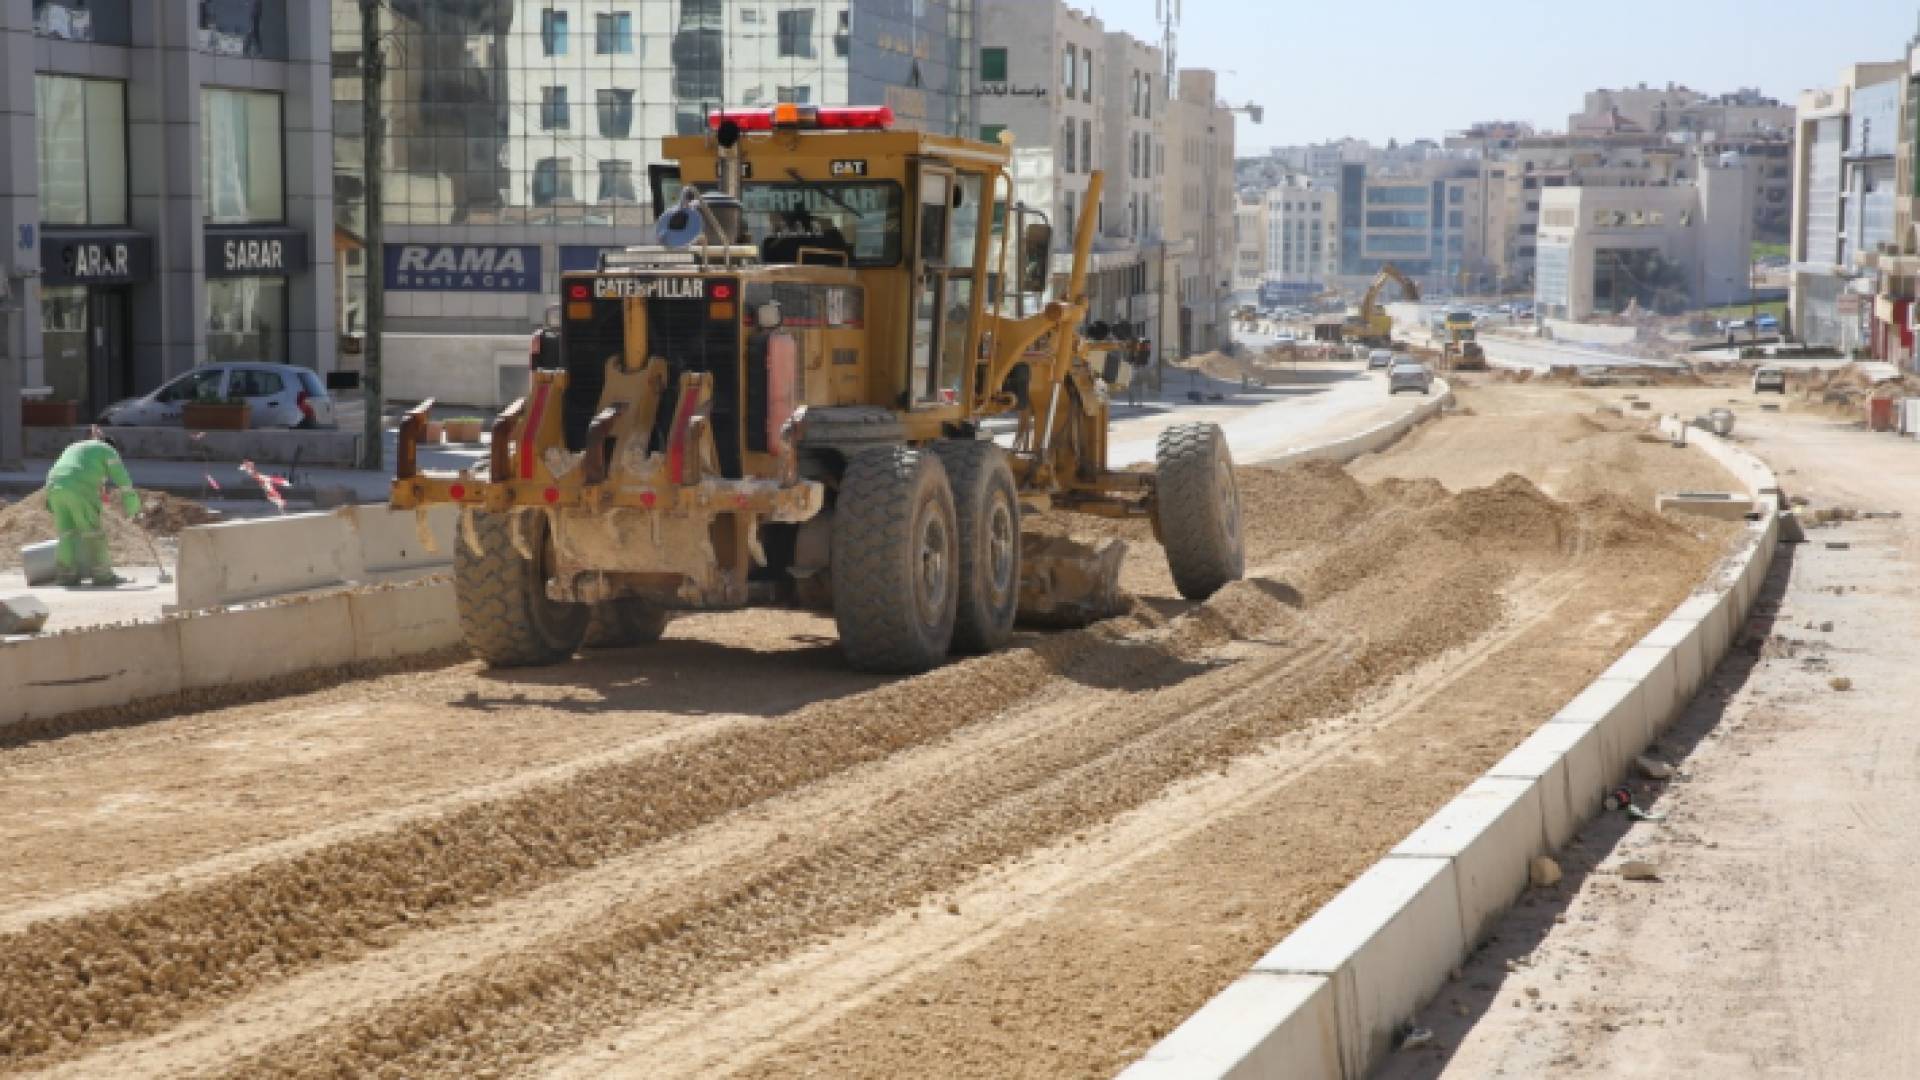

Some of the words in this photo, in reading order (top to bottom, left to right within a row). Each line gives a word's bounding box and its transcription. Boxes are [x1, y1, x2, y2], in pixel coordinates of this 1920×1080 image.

[833, 161, 864, 174] CAT
[223, 240, 282, 270] SARAR
[398, 246, 525, 273] RAMA
